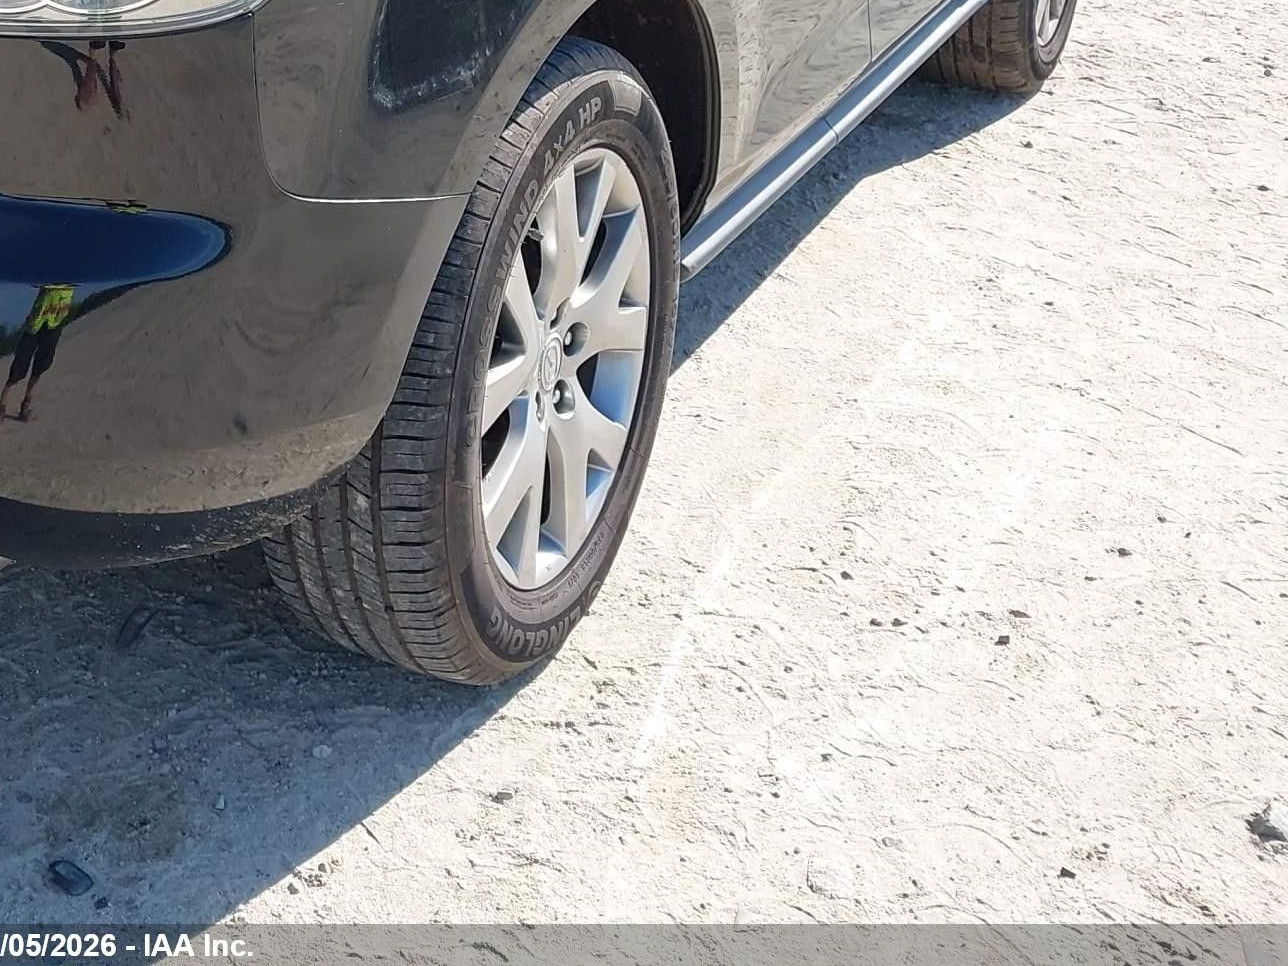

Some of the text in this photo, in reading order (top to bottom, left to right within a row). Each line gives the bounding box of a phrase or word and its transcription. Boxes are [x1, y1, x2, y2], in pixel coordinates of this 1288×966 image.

[465, 179, 539, 448] CROSSWIND
[578, 96, 603, 131] HP
[485, 606, 582, 657] LINGLONG
